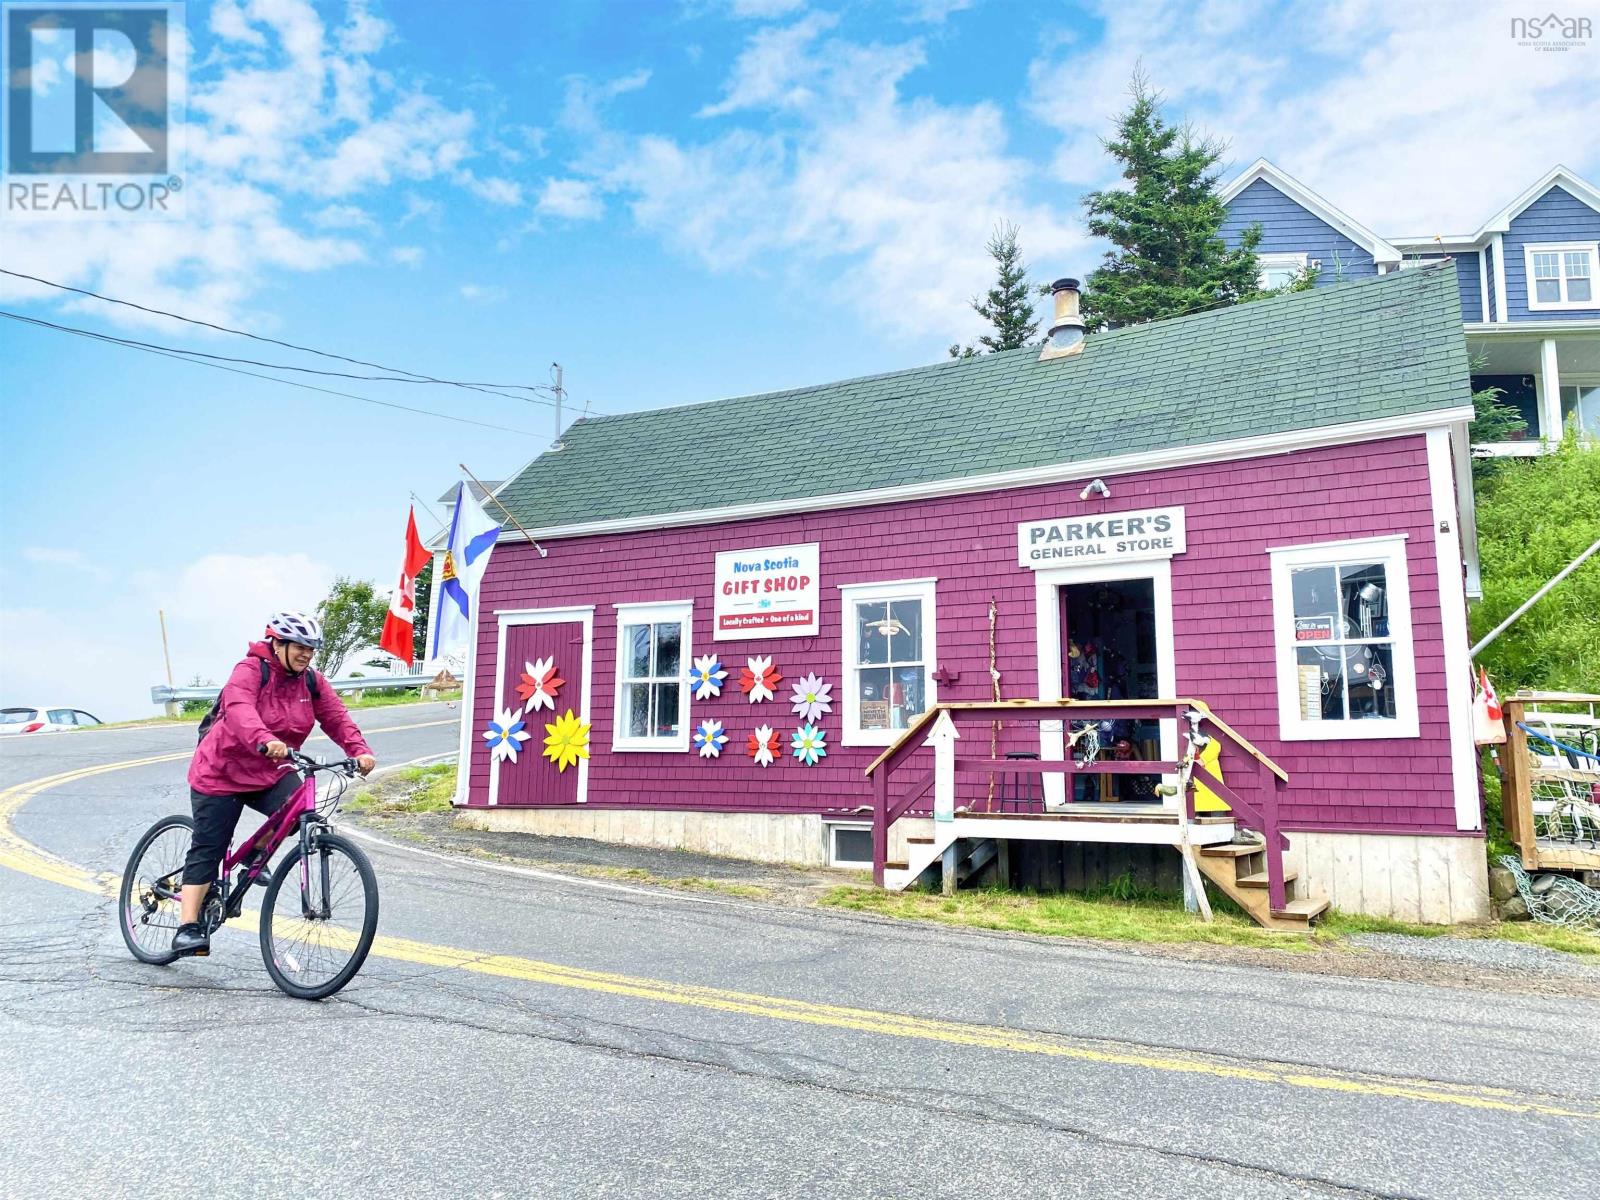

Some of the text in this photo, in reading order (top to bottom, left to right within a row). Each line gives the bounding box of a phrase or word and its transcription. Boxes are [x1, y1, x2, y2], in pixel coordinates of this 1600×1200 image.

[1030, 514, 1171, 545] PARKER'S
[1030, 537, 1174, 560] GENERAL STORE
[734, 556, 799, 573] Nova Scotia
[722, 575, 810, 595] GIFT SHOP
[723, 617, 742, 627] Locally
[743, 615, 764, 624] Crafted
[783, 614, 789, 622] of
[795, 613, 809, 621] kind
[1296, 629, 1330, 640] OPEN
